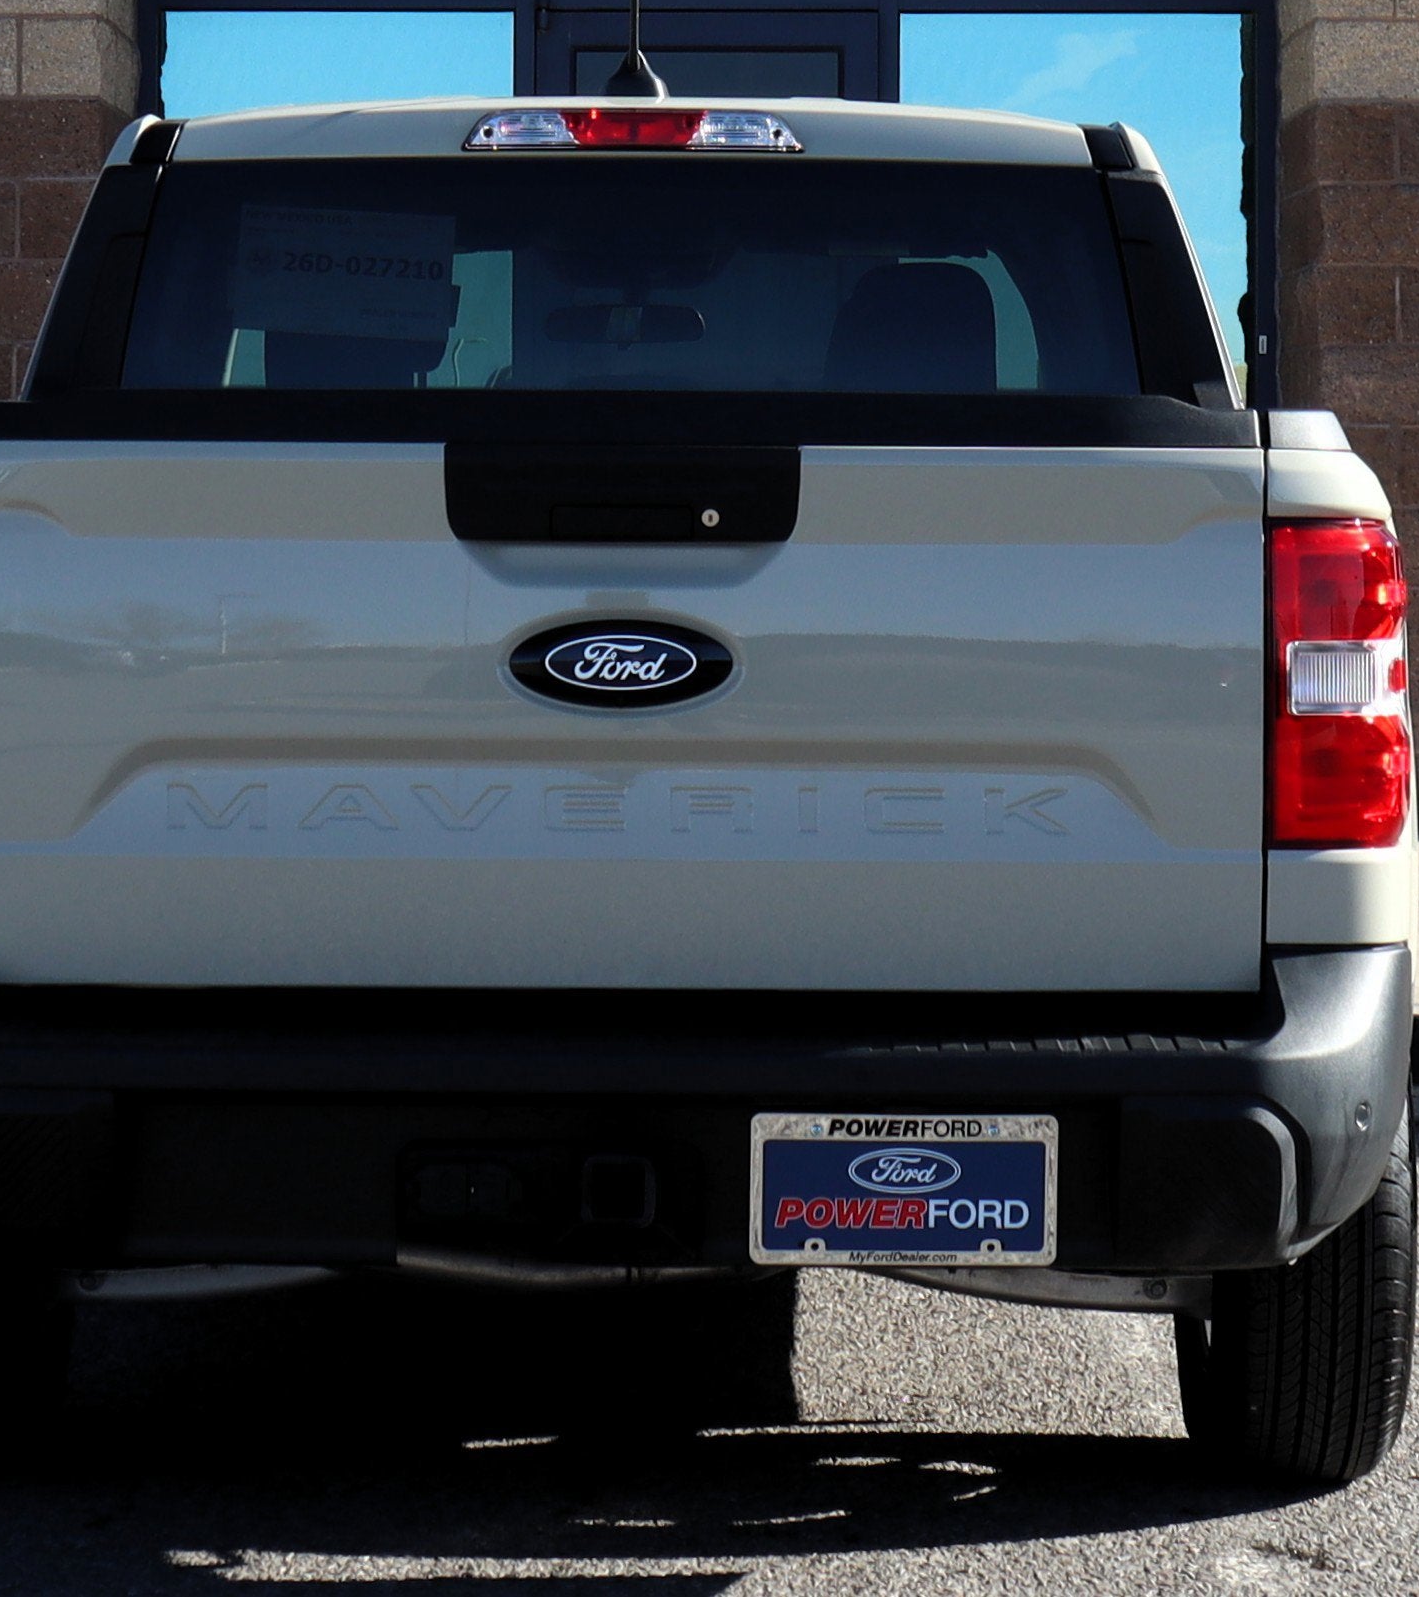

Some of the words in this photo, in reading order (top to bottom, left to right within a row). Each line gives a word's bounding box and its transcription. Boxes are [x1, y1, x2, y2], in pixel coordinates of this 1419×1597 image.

[282, 251, 444, 281] 26D-027210
[574, 642, 668, 681] Ford
[166, 782, 1070, 835] MAVERICK
[827, 1118, 983, 1138] POWERFORD
[870, 1156, 938, 1184] Ford
[775, 1197, 1030, 1230] POWERFORD
[848, 1251, 957, 1265] MyFordDealer.com
